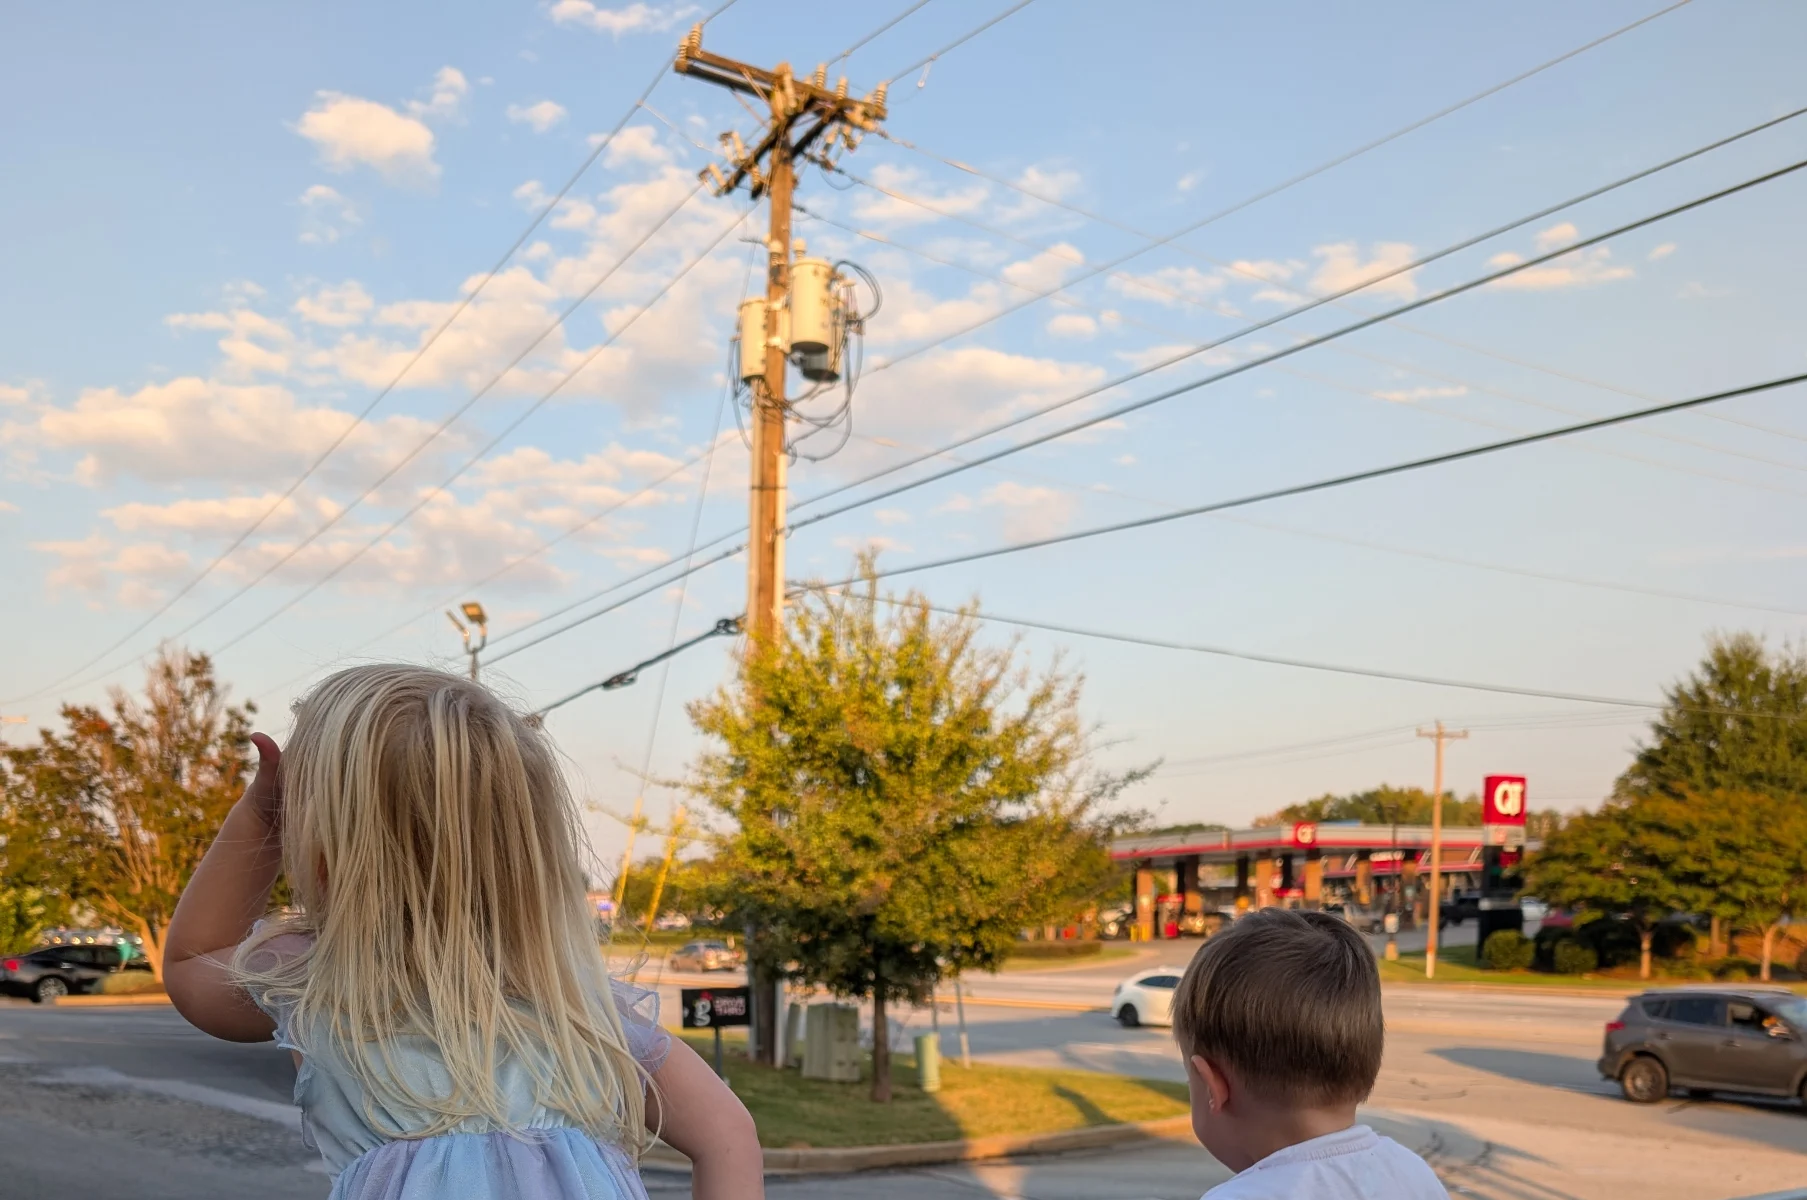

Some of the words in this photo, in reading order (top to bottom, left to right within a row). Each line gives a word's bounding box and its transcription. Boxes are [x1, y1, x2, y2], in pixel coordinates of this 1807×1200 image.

[1494, 780, 1524, 816] QT
[714, 996, 745, 1006] DRIVE
[716, 1006, 745, 1016] THRU
